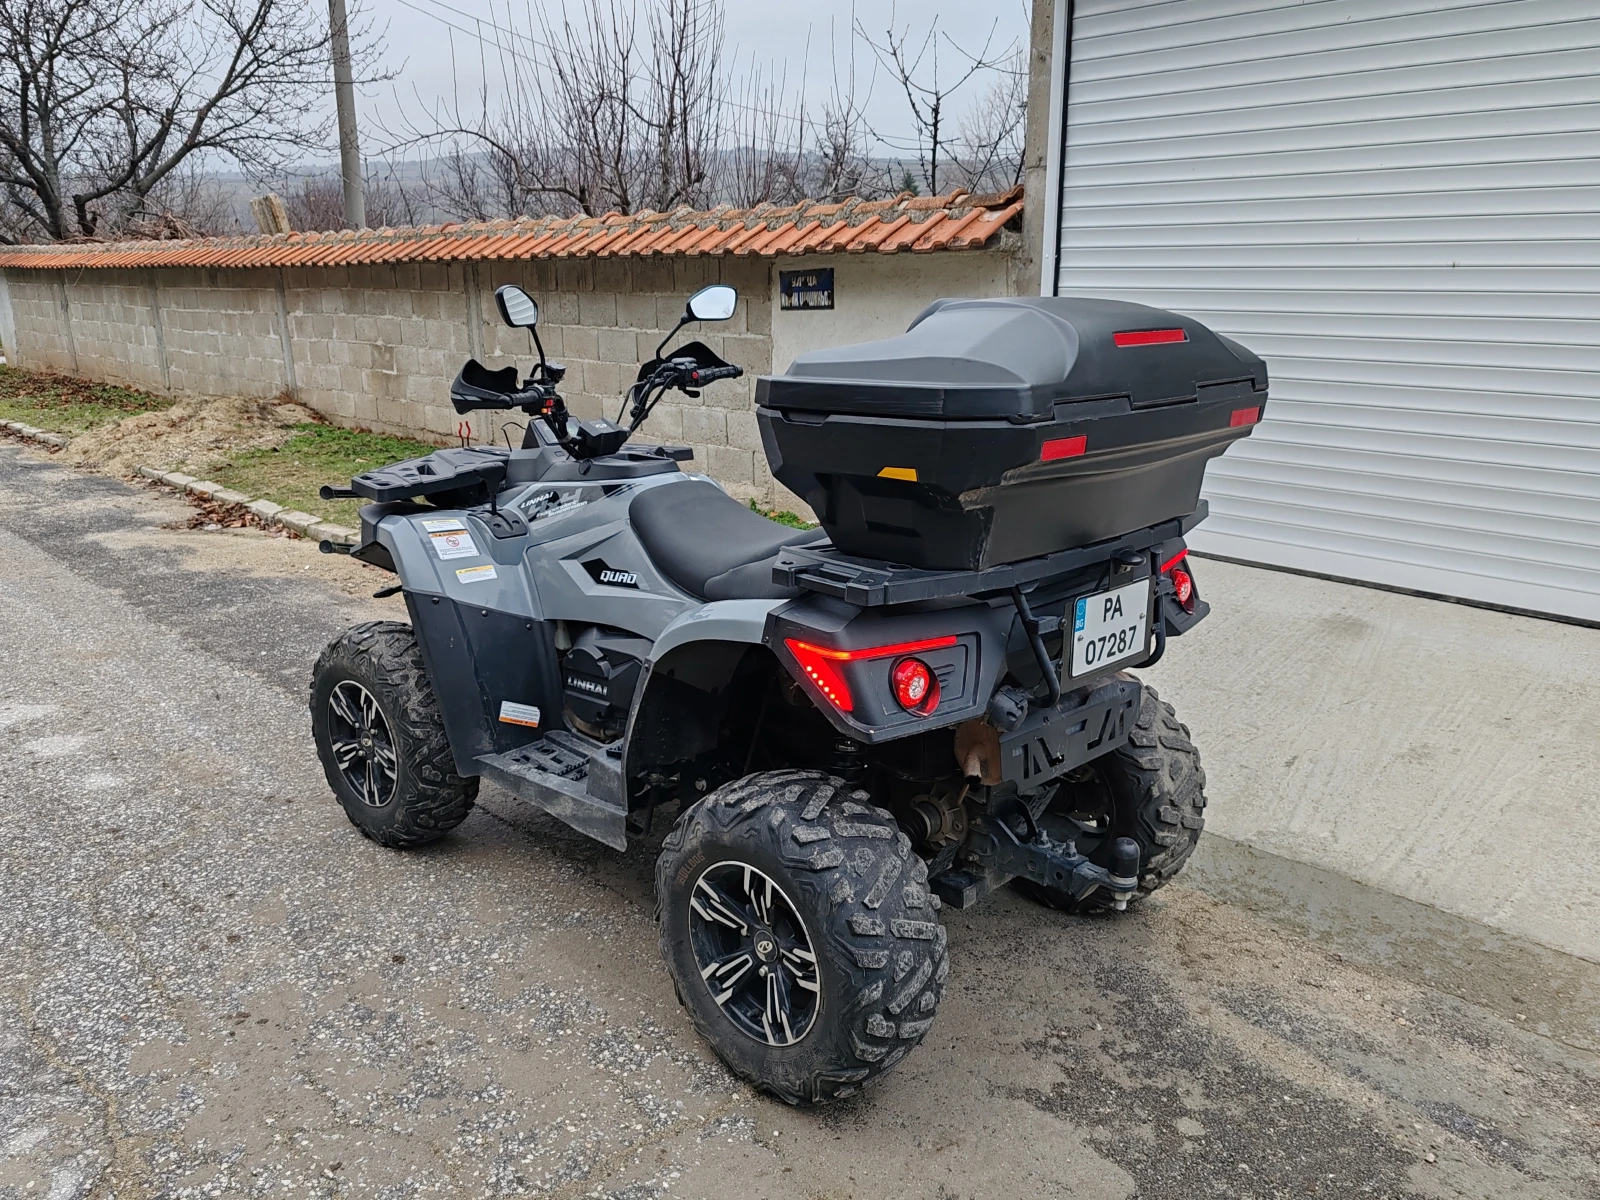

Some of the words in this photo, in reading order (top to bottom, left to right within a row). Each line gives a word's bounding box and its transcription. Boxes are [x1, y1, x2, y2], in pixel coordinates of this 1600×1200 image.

[520, 491, 554, 509] LINHAI
[600, 570, 637, 584] QUAD
[1103, 594, 1123, 623] PA
[1075, 618, 1084, 629] BG
[1085, 625, 1137, 666] 07287
[567, 675, 608, 696] LINHAI
[676, 851, 706, 886] BULLDOG
